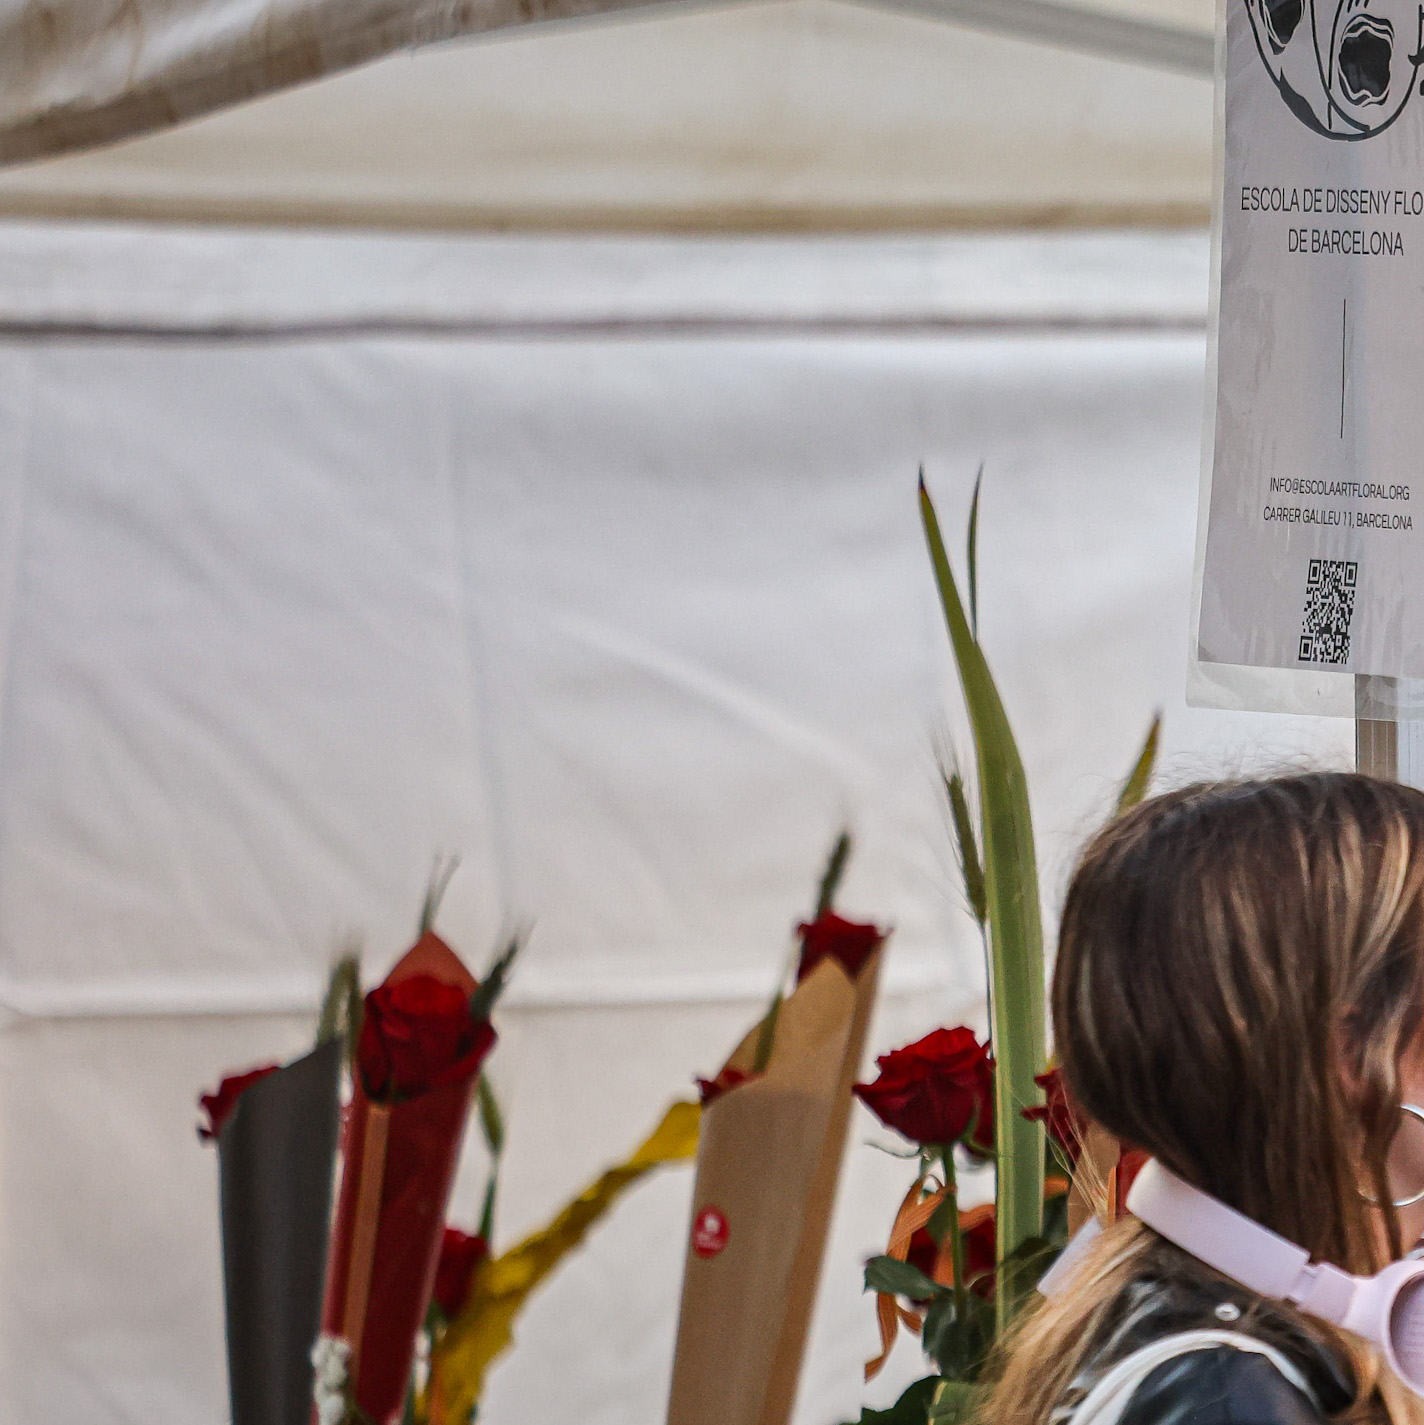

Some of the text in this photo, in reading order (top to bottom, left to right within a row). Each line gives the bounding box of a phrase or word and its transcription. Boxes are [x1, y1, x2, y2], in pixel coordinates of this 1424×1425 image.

[1241, 187, 1300, 212] ESCOLA
[1303, 188, 1323, 213] DE
[1326, 189, 1391, 214] DISSENY
[1288, 228, 1404, 256] DE BARCELONA
[1263, 506, 1301, 523] CARRER
[1303, 509, 1341, 526] GALILEU
[1356, 512, 1413, 530] BARCELONA
